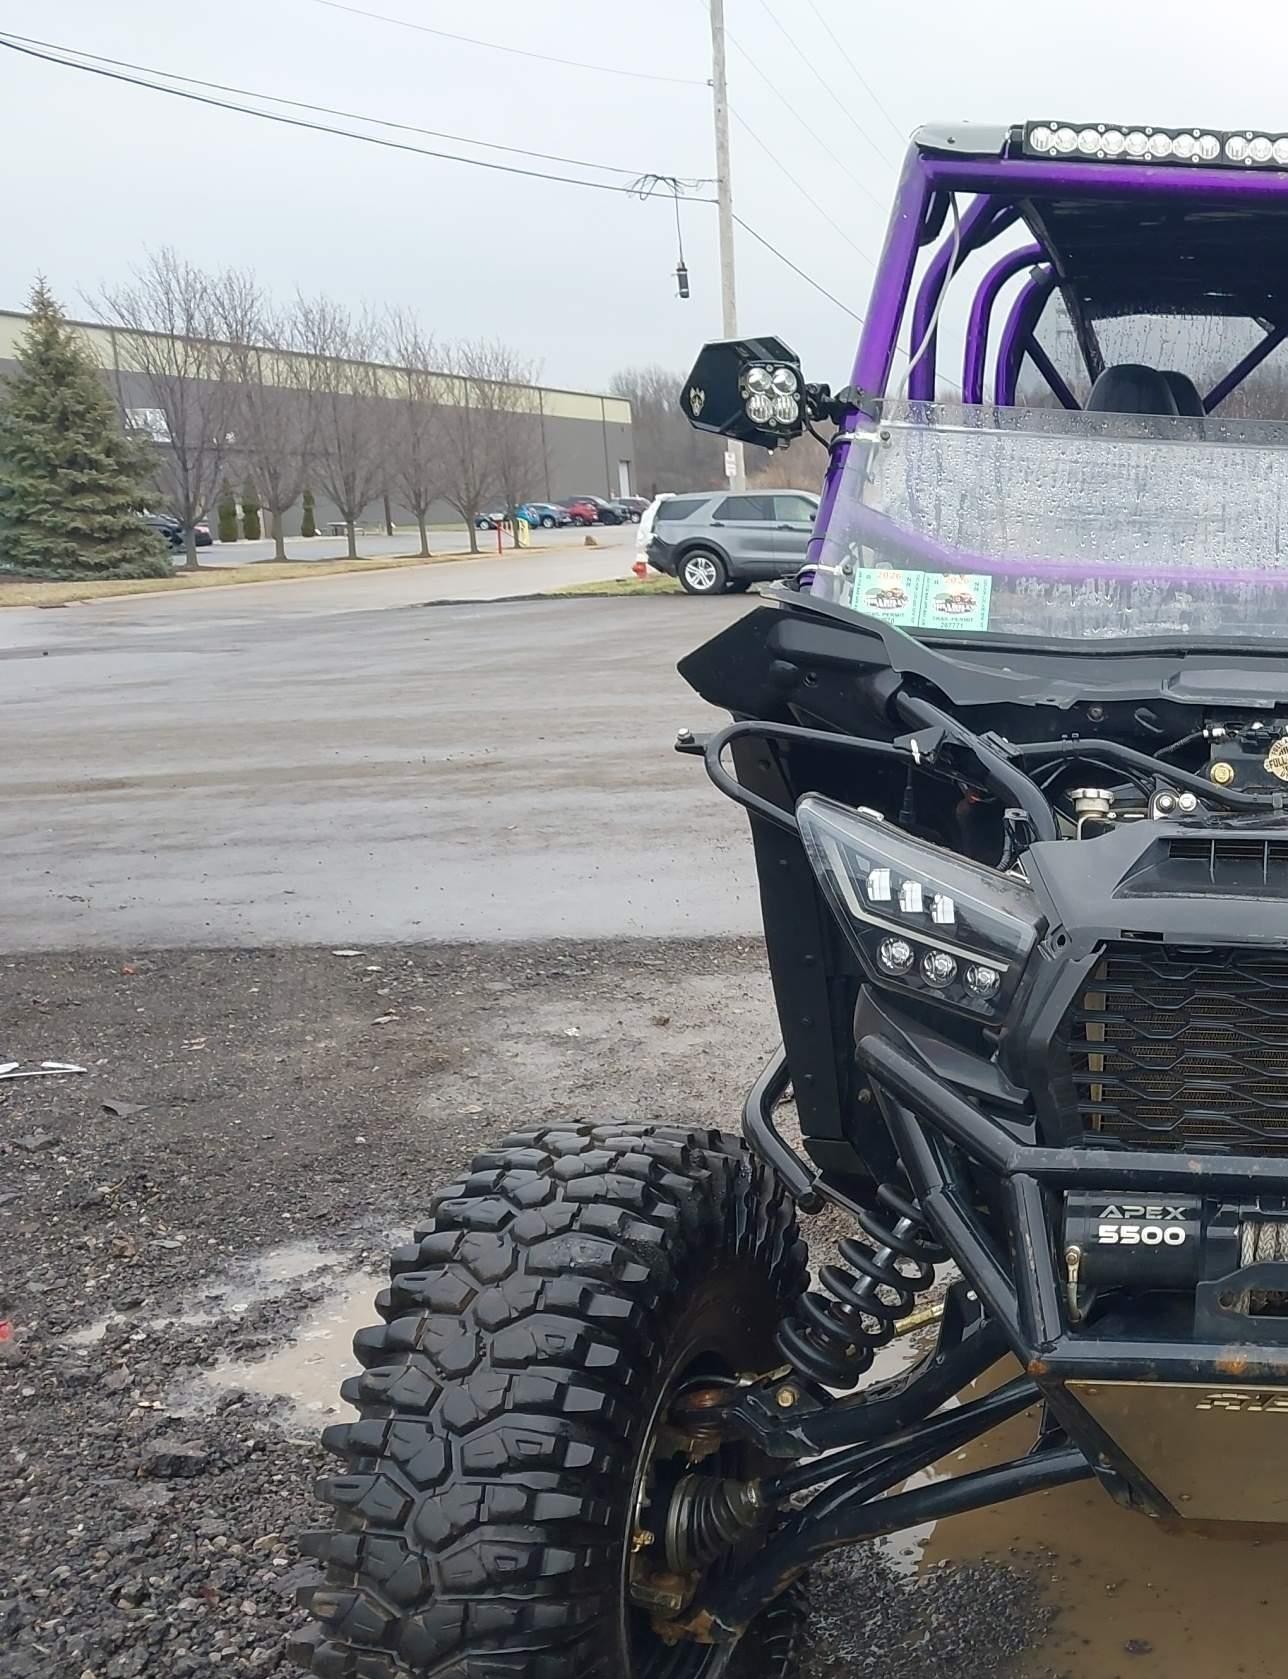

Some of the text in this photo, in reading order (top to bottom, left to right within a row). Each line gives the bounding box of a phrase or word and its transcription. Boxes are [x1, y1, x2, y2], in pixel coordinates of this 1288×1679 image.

[1268, 757, 1287, 769] FULL
[1099, 1205, 1187, 1220] APEX
[1098, 1225, 1186, 1246] 5500
